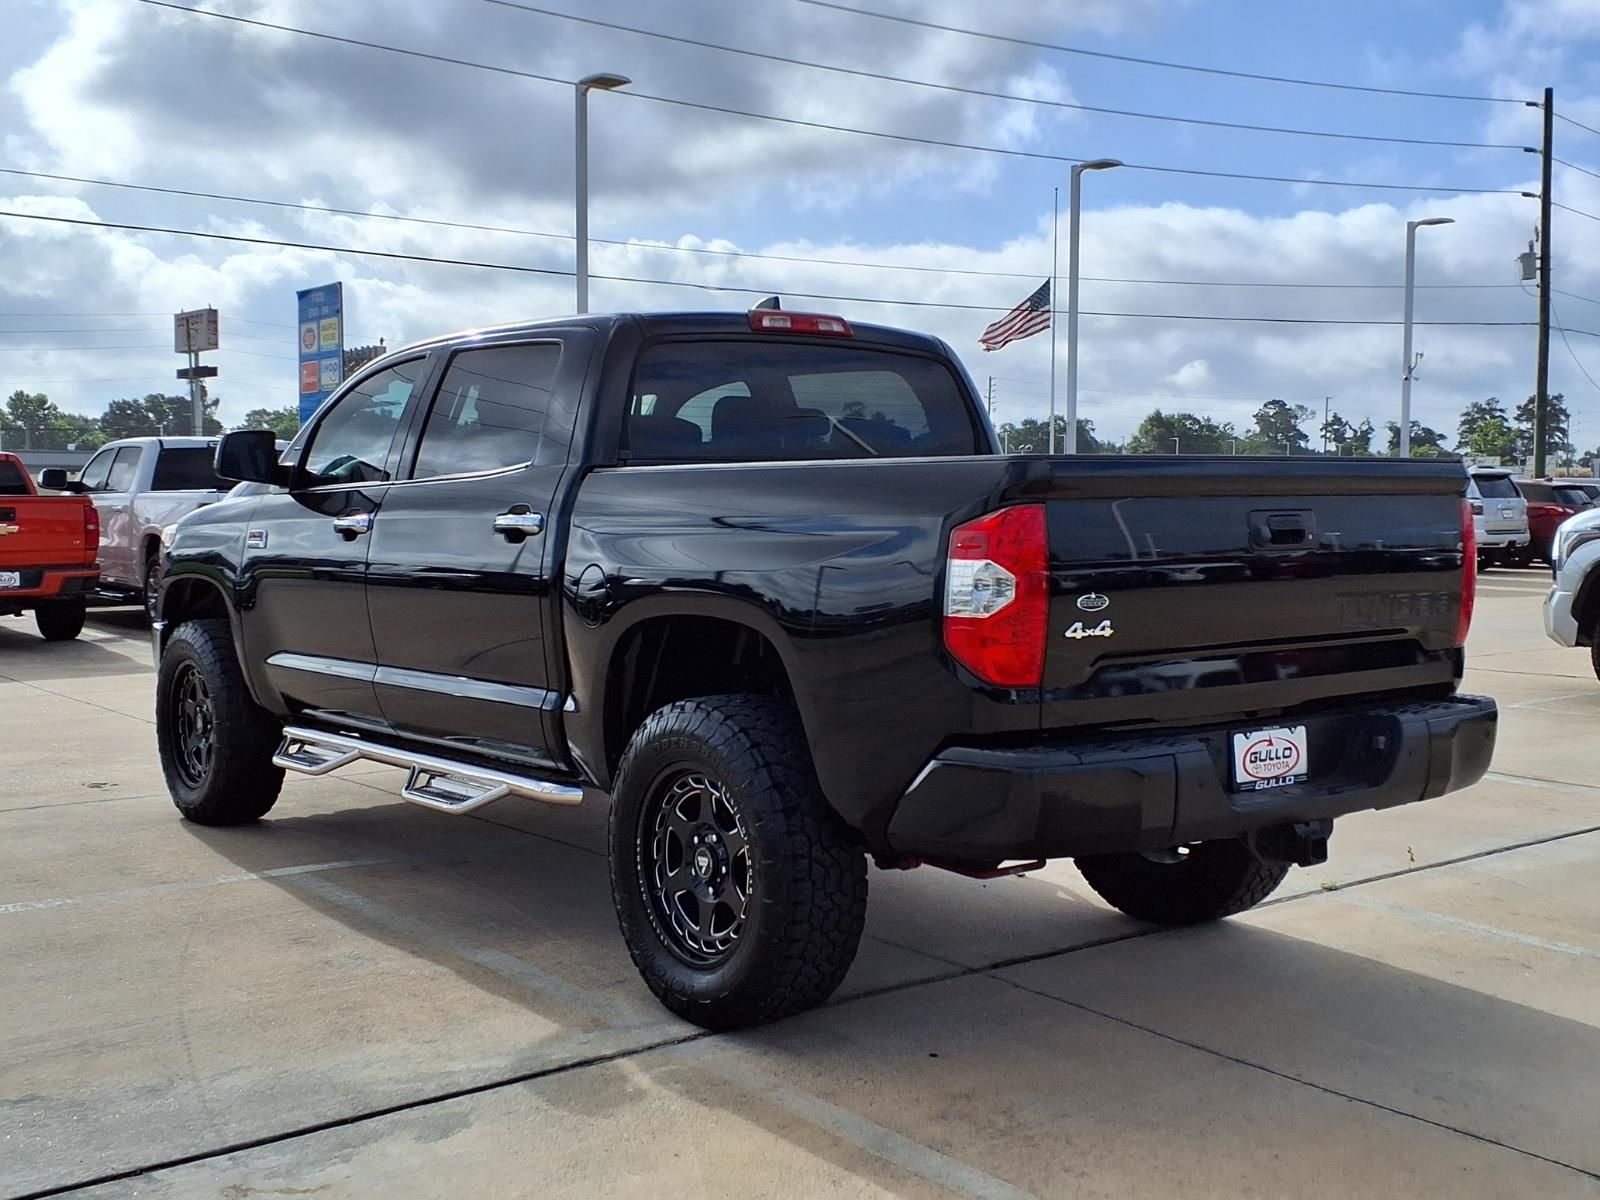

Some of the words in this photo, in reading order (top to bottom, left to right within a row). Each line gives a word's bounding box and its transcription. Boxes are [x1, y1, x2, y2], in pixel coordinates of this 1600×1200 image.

[1065, 620, 1114, 639] 4x4
[1249, 746, 1292, 764] GULLO
[1263, 761, 1290, 772] TOYOTA
[1255, 776, 1294, 790] GULLO
